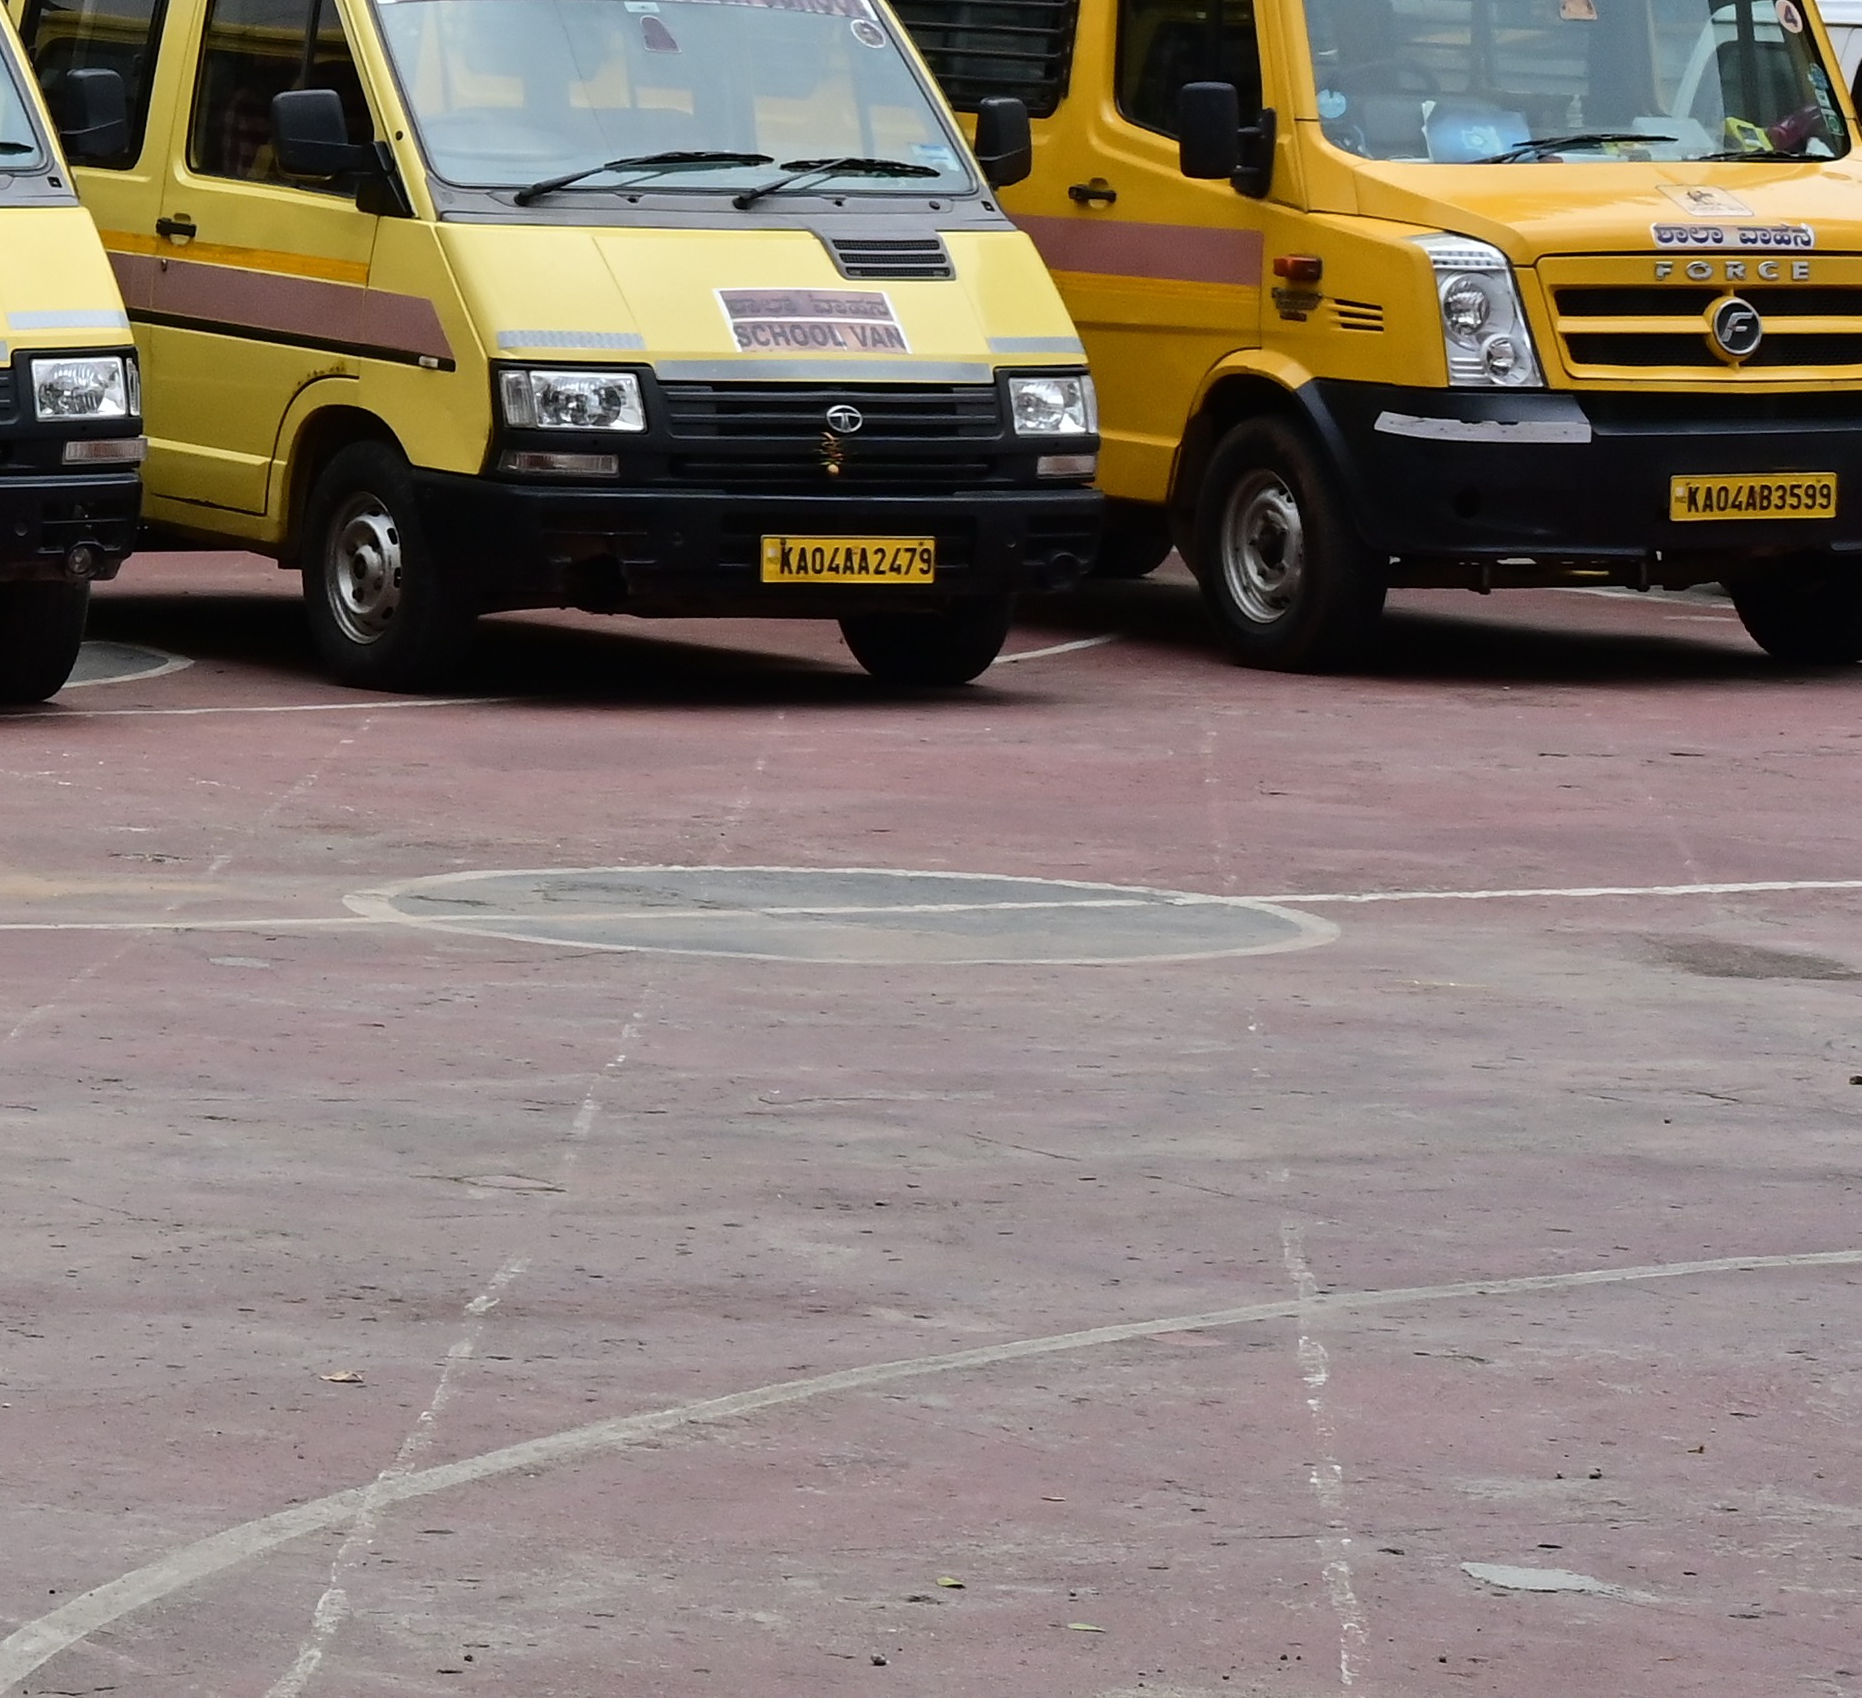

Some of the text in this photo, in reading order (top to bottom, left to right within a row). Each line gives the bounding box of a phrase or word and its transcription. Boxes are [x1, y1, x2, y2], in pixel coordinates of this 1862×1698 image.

[1784, 5, 1798, 29] 4
[1653, 226, 1724, 244] ಶಾಲಾ
[1655, 260, 1811, 282] FORCE
[732, 324, 907, 350] SCHOOL VAN
[1687, 483, 1832, 513] KA04AB3599
[779, 546, 933, 576] KA04AA2479
